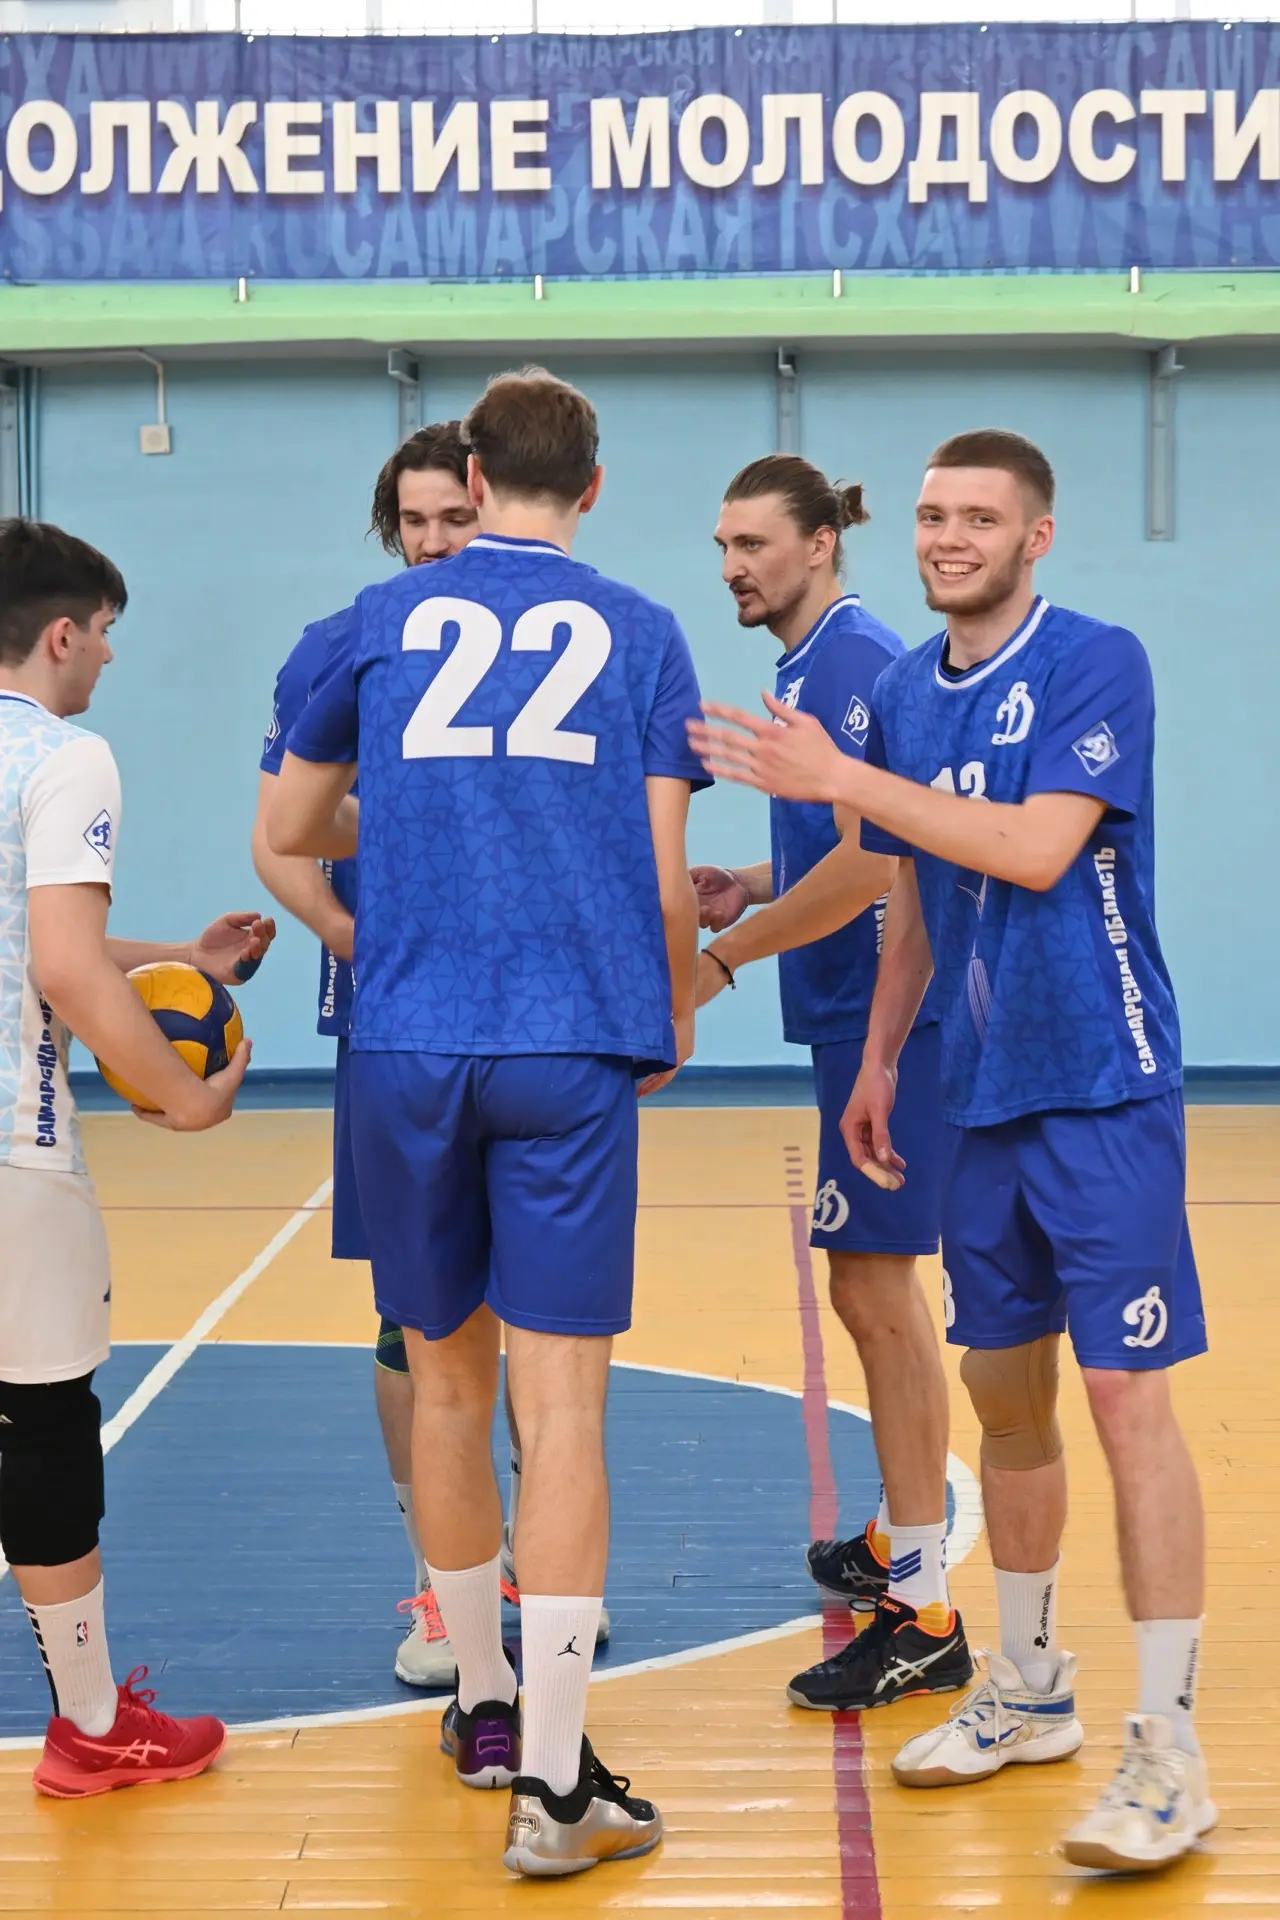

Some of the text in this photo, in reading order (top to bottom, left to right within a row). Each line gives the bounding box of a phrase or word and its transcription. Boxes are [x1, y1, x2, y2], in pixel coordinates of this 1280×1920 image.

[0, 88, 1280, 203] ОЛЖЕНИЕ МОЛОДОСТИ
[402, 596, 612, 765] 22
[321, 947, 338, 1018] САМАР
[1093, 847, 1157, 1075] САМАРСКАЯ ОБЛАСТЬ
